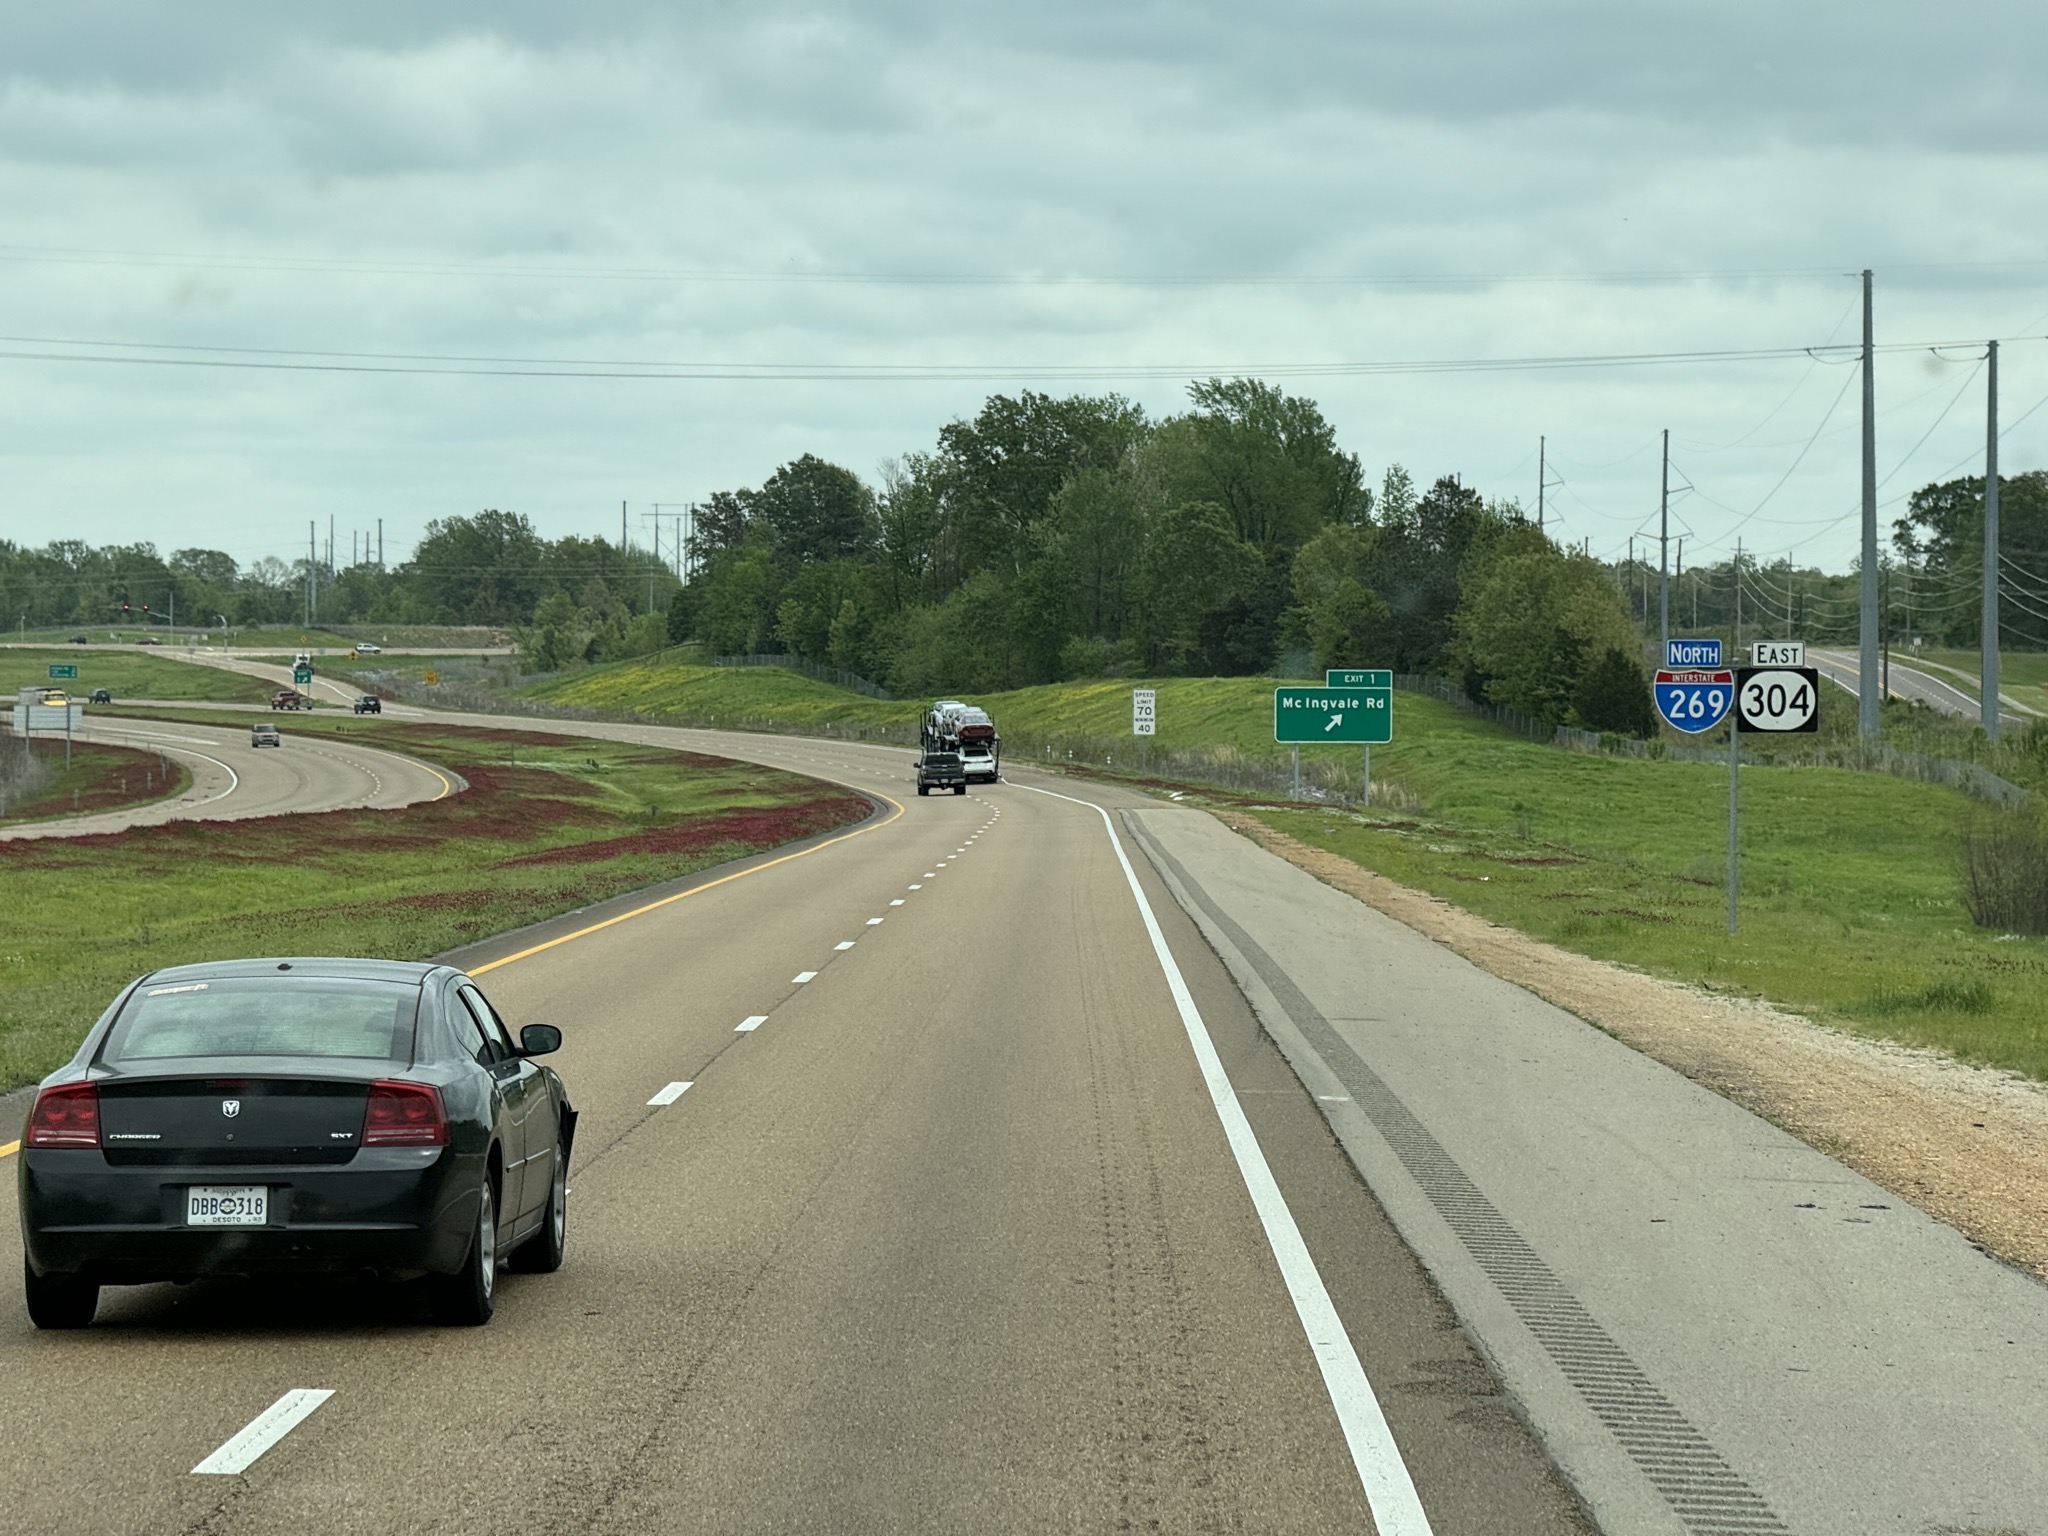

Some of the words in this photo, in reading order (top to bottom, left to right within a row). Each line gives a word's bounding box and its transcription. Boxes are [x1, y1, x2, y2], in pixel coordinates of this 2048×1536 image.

[1670, 643, 1718, 664] NORTH
[1757, 645, 1799, 664] EAST
[1344, 675, 1364, 683] EXIT
[1370, 674, 1375, 685] 1
[1672, 674, 1716, 683] INTERSTATE
[1366, 697, 1385, 709] Rd
[1669, 689, 1724, 719] 269
[1746, 684, 1809, 717] 304
[1136, 706, 1152, 716] 70
[1138, 724, 1151, 733] 40
[191, 1197, 218, 1216] DBB
[236, 1197, 263, 1216] 318
